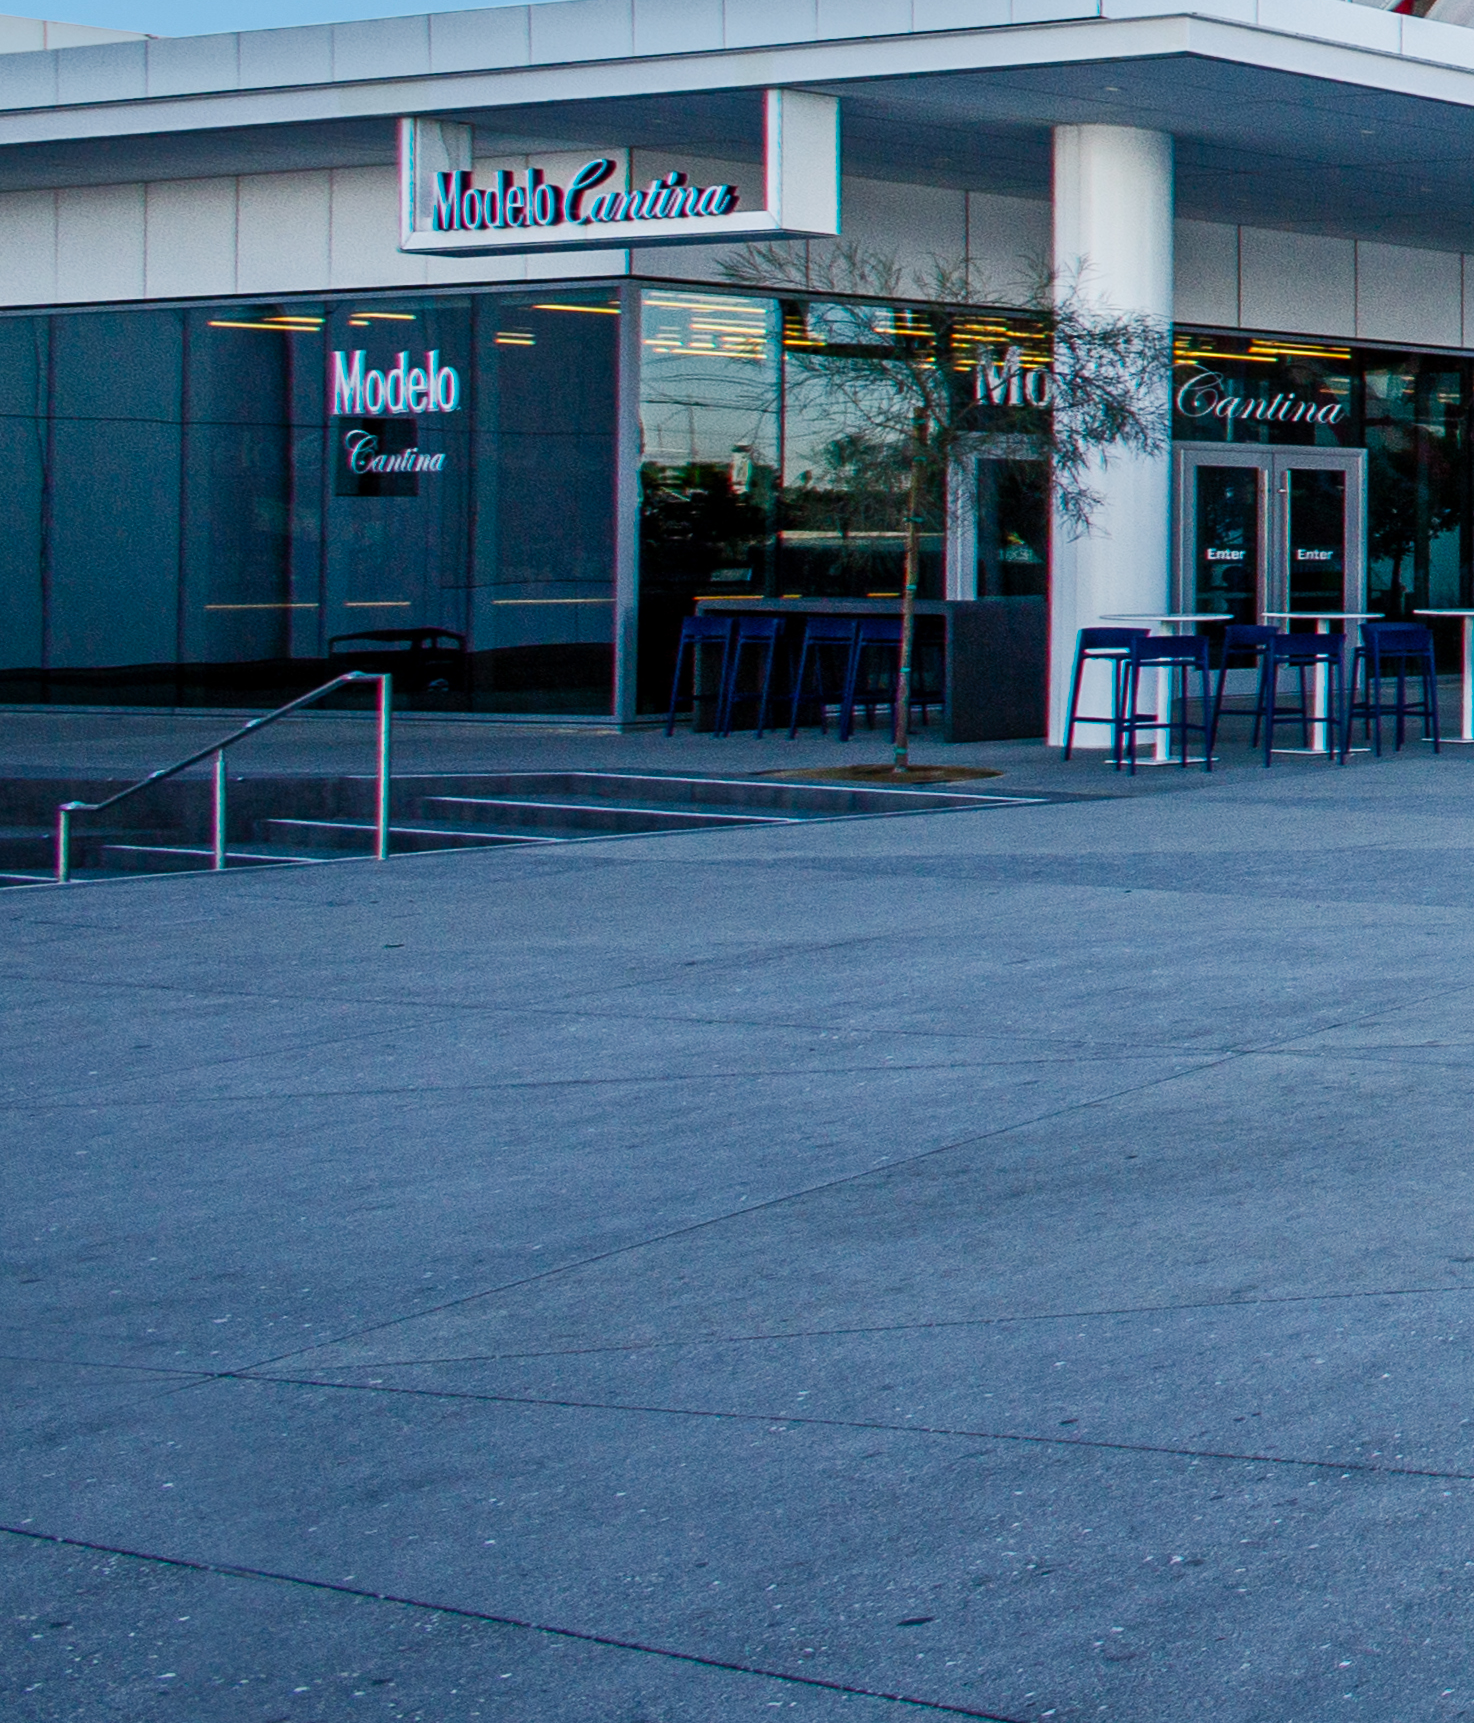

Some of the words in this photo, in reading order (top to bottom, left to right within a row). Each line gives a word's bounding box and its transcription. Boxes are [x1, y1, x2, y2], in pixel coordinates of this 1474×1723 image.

[432, 167, 563, 231] Modelo
[564, 158, 740, 225] Cantina
[330, 350, 460, 415] Modelo
[1174, 363, 1345, 424] Cantina
[343, 429, 446, 474] Cantina
[1205, 548, 1246, 560] Enter
[1296, 549, 1334, 560] Enter
